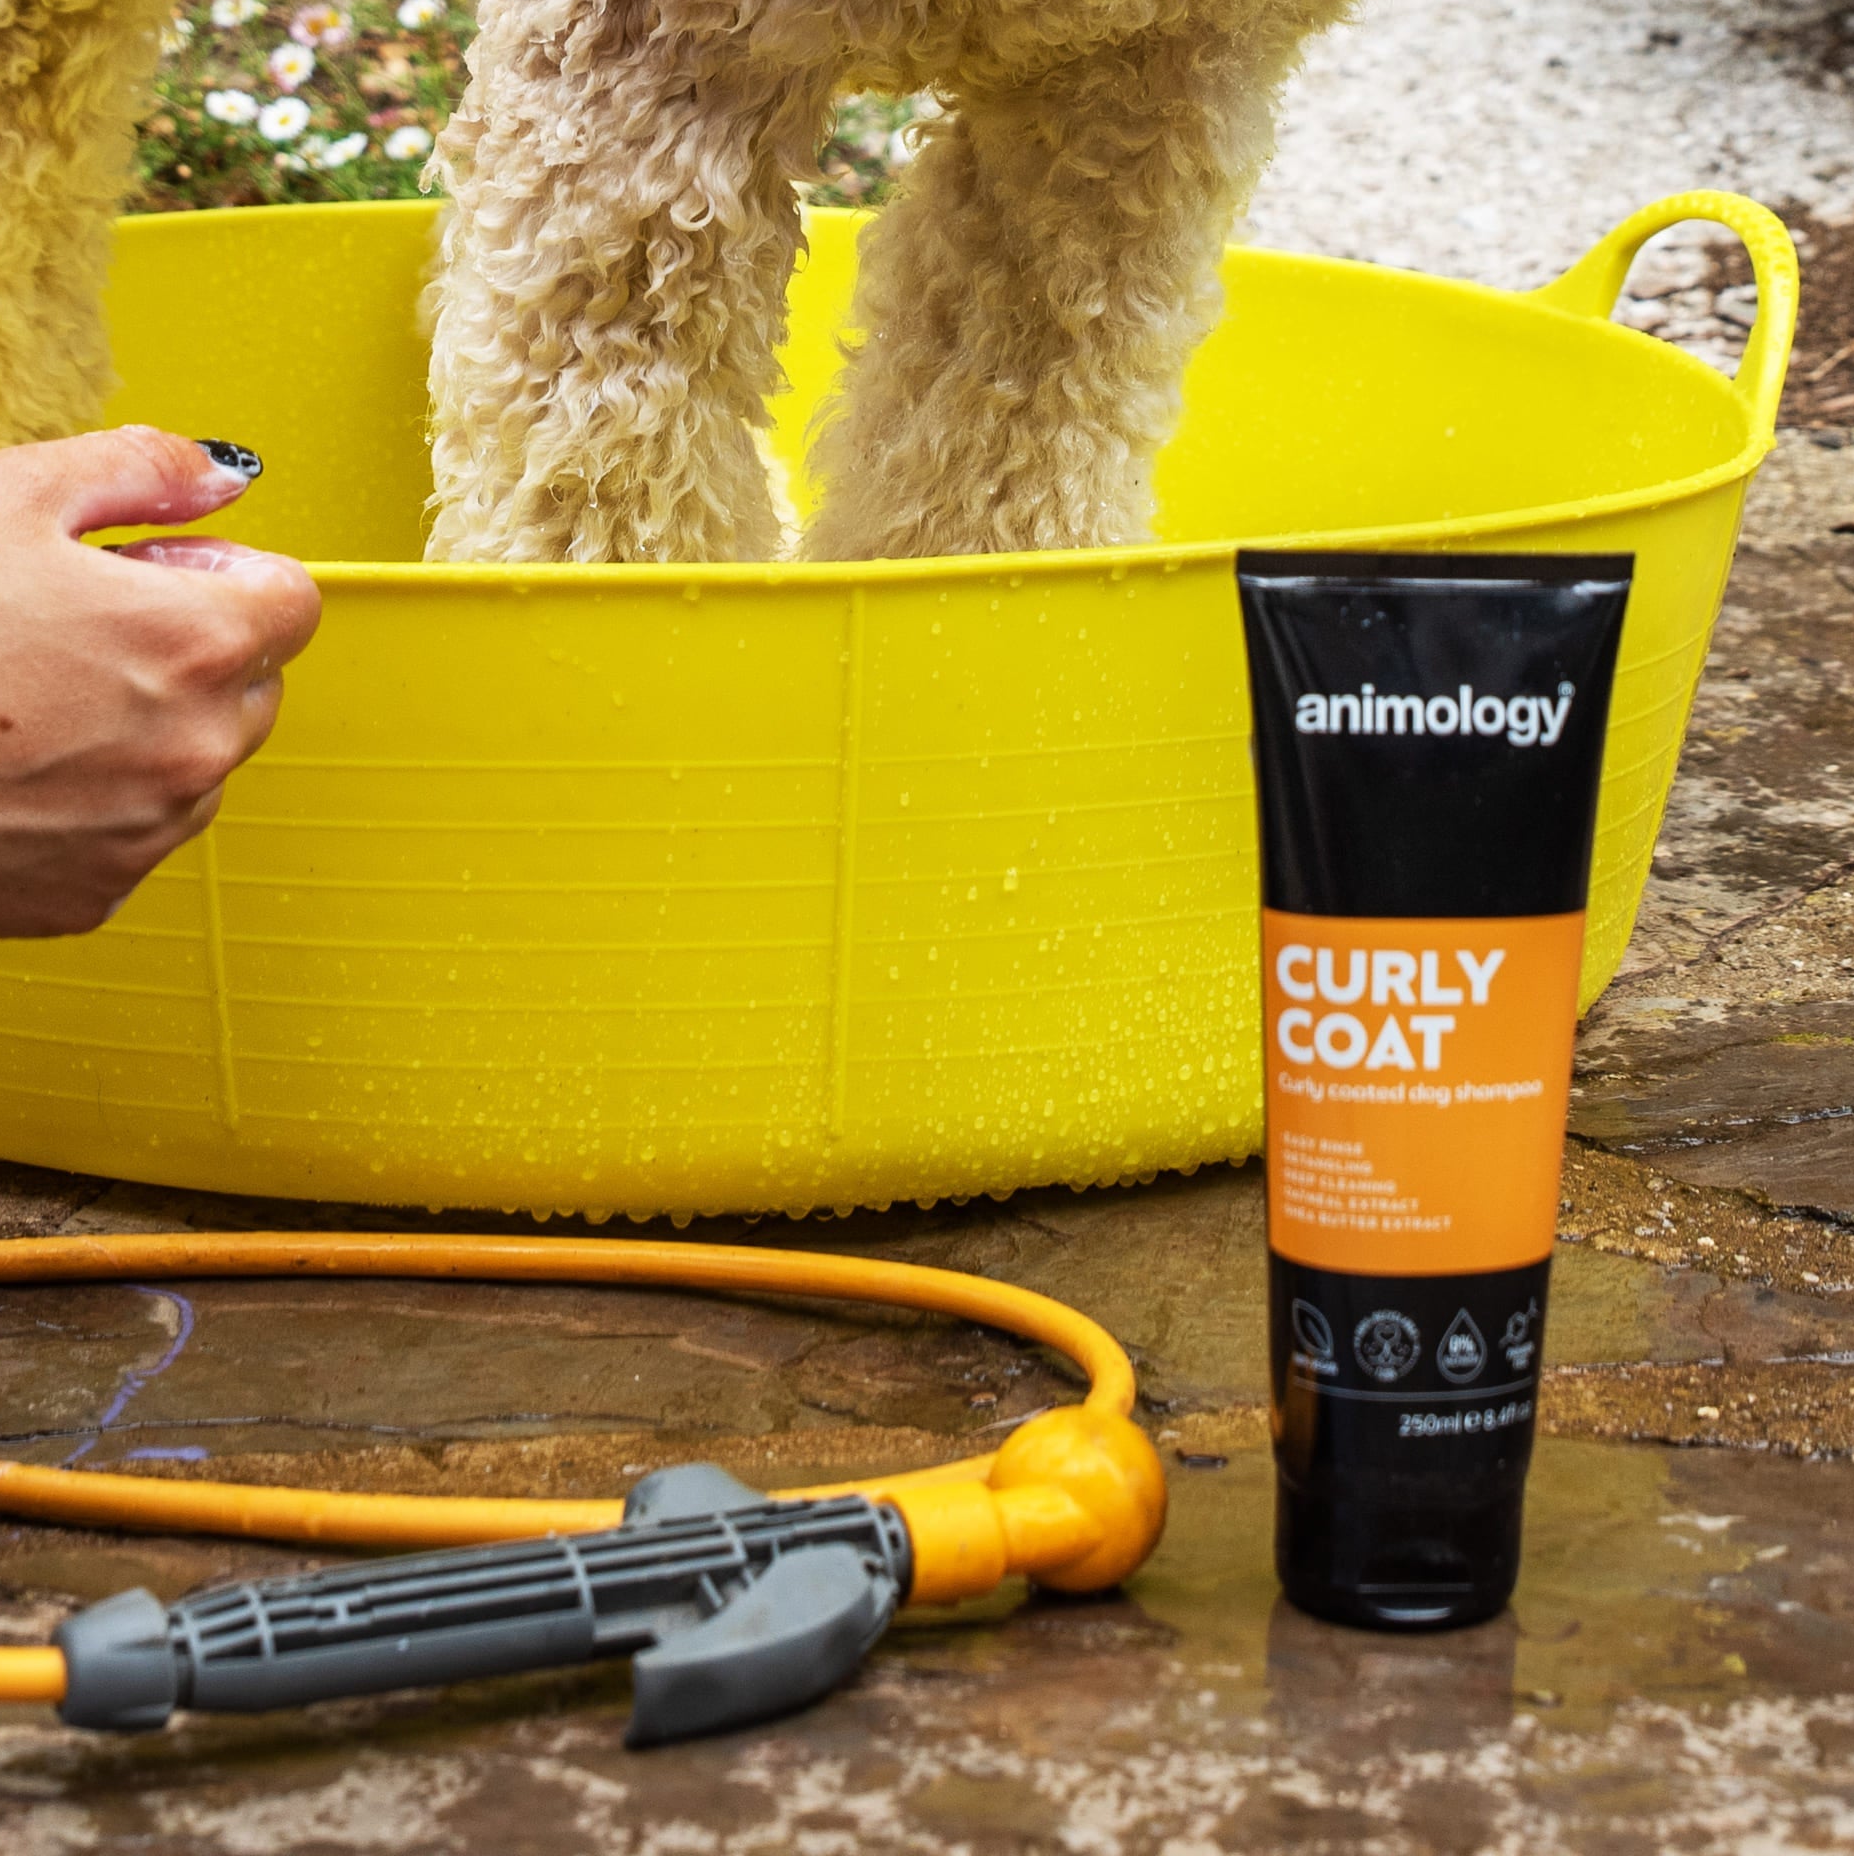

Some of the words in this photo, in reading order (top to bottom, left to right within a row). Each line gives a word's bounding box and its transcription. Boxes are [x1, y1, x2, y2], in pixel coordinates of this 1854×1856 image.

[1276, 943, 1506, 1006] CURLY
[1276, 1007, 1455, 1071] COAT
[1278, 1071, 1324, 1104] Curly
[1327, 1081, 1405, 1103] coated
[1409, 1082, 1452, 1108] dog
[1455, 1078, 1544, 1102] shampoo
[1399, 1410, 1462, 1437] 250ml
